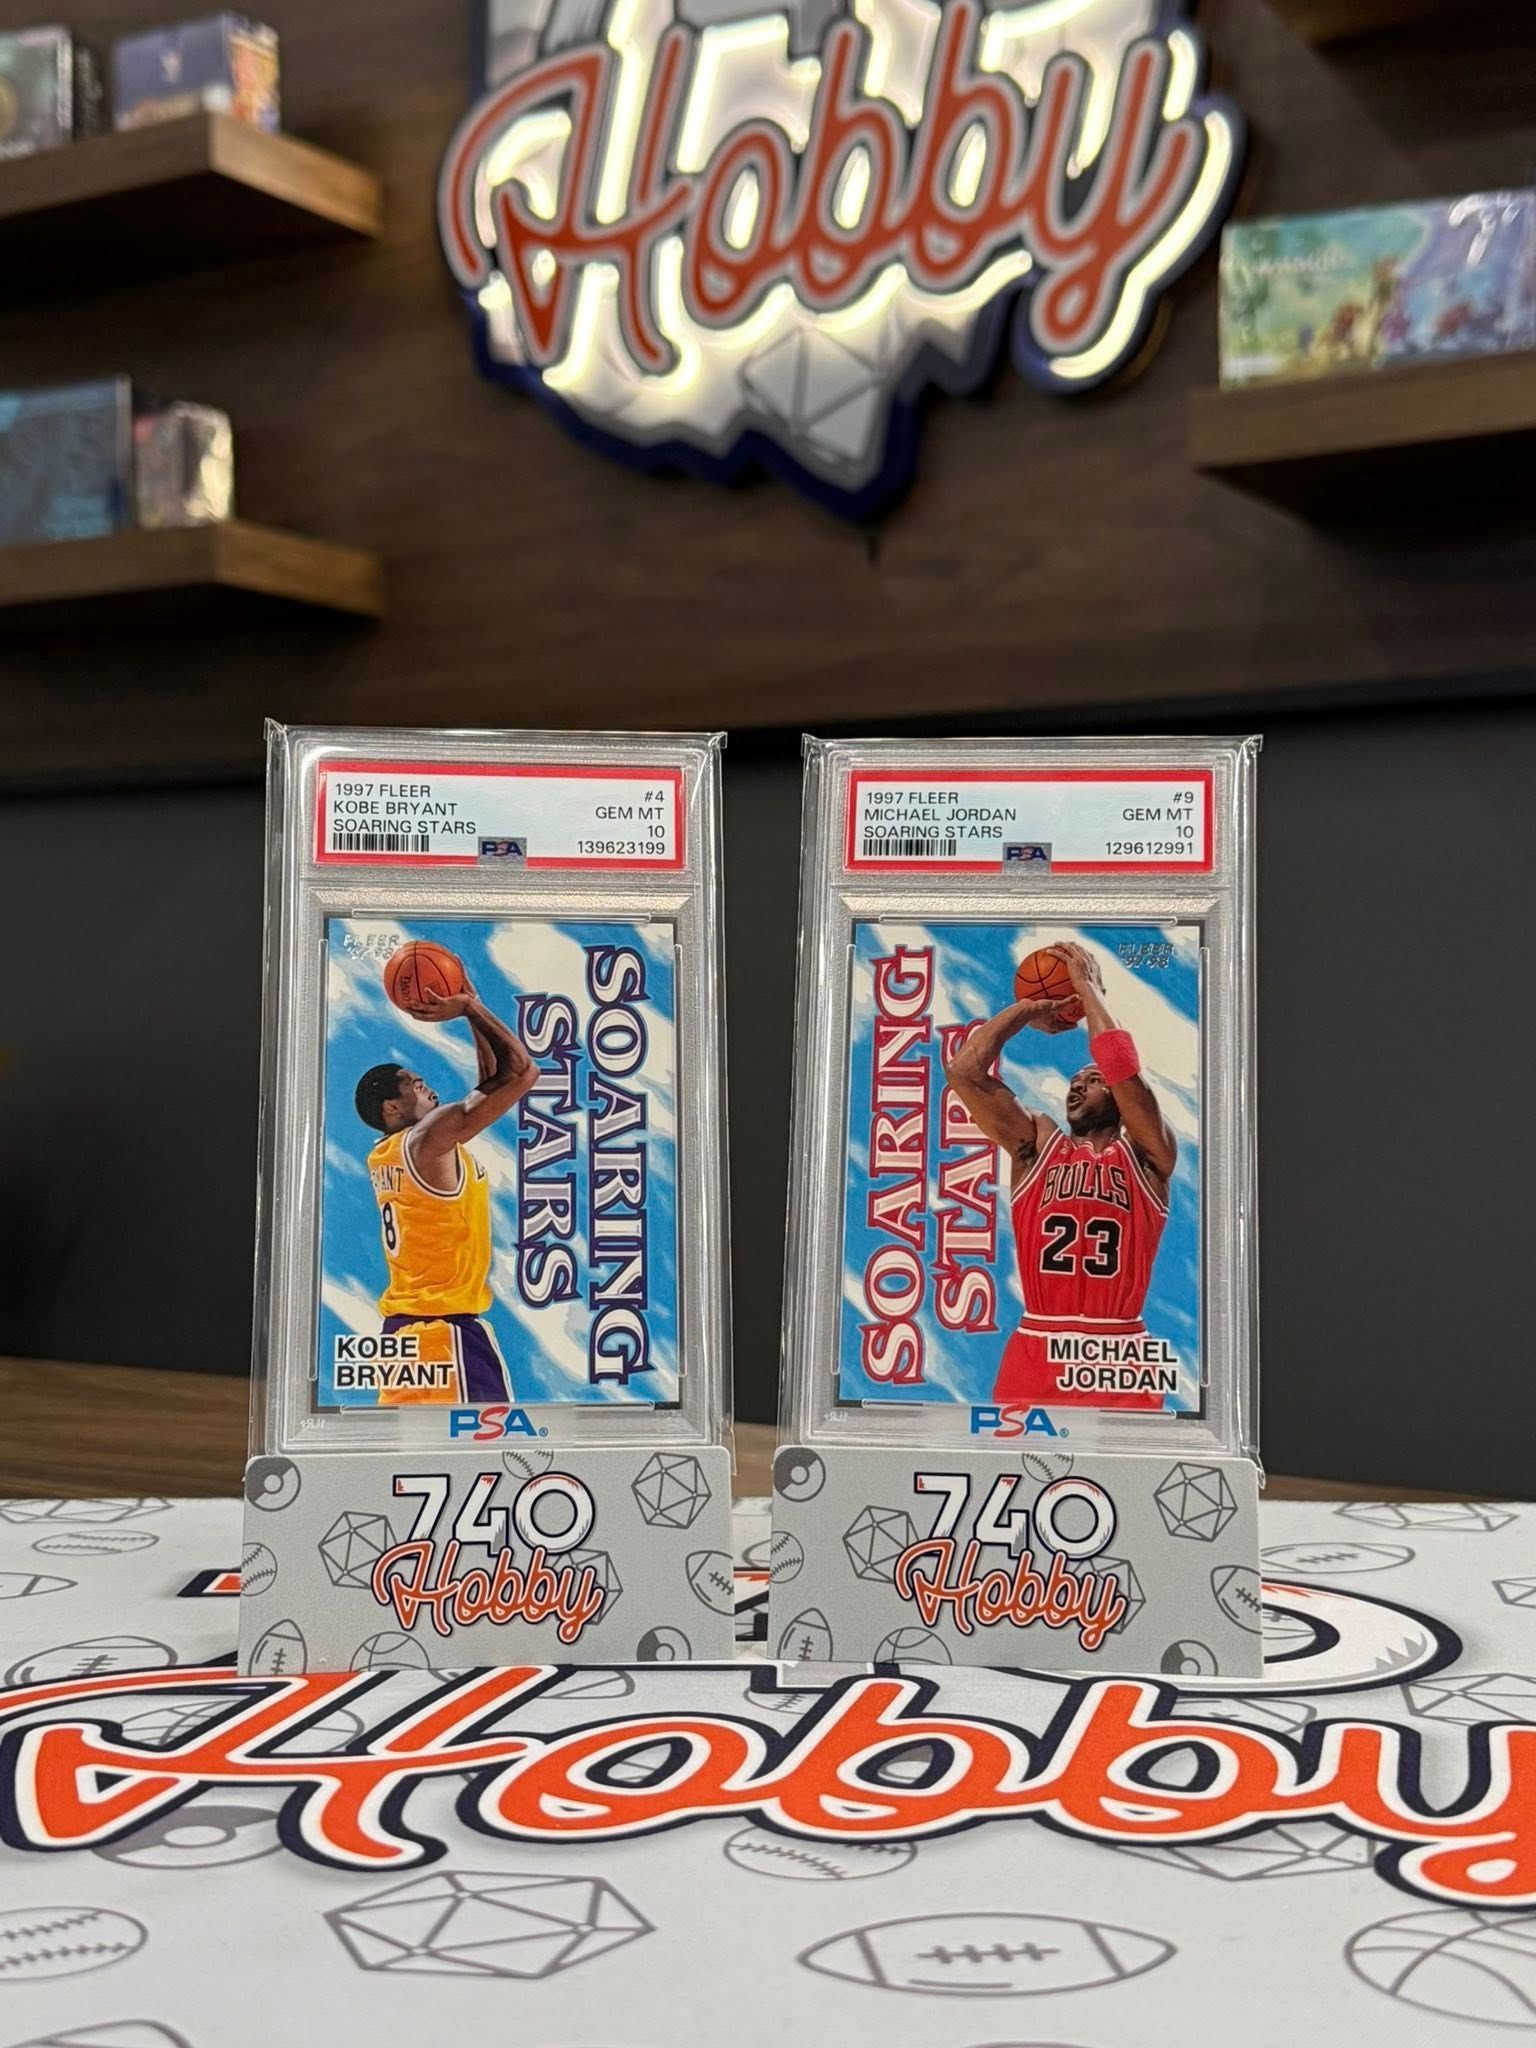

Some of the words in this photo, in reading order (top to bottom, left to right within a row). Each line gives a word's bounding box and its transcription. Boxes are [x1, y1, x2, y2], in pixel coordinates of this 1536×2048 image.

[440, 0, 1210, 370] Hobby
[334, 782, 373, 797] 1997
[379, 784, 431, 798] FLEER
[643, 789, 665, 803] #4
[866, 791, 904, 805] 1997
[908, 791, 959, 805] FLEER
[1172, 791, 1194, 805] #9
[333, 800, 379, 815] KOBE
[385, 802, 459, 816] BRYANT
[595, 806, 633, 820] GEM
[638, 807, 664, 820] MT
[863, 808, 942, 822] MICHAEL
[946, 808, 1017, 822] JORDAN
[1122, 807, 1161, 821] GEM
[1166, 808, 1193, 821] MT
[333, 817, 413, 833] SOARING
[417, 819, 477, 834] STARS
[647, 825, 665, 839] 10
[863, 825, 939, 839] SOARING
[944, 825, 1003, 840] STARS
[1175, 825, 1194, 839] 10
[481, 840, 523, 857] PSA
[577, 839, 666, 856] 139623199
[1006, 845, 1048, 862] PSA
[1105, 841, 1194, 856] 129612991
[513, 991, 585, 1309] STARS
[584, 944, 656, 1386] SOARING
[859, 943, 937, 1386] SOARING
[1038, 1159, 1132, 1214] BULLS
[380, 1199, 401, 1257] 8
[1039, 1212, 1123, 1279] 23
[336, 1334, 420, 1361] KOBE
[1048, 1336, 1179, 1364] MICHAEL
[334, 1361, 456, 1389] BRYANT
[1057, 1365, 1178, 1392] JORDAN
[392, 1470, 596, 1558] 740
[913, 1471, 1117, 1561] 740
[371, 1538, 604, 1645] Hobby
[895, 1536, 1127, 1653] Hobby
[0, 1661, 1536, 1906] Hobby
